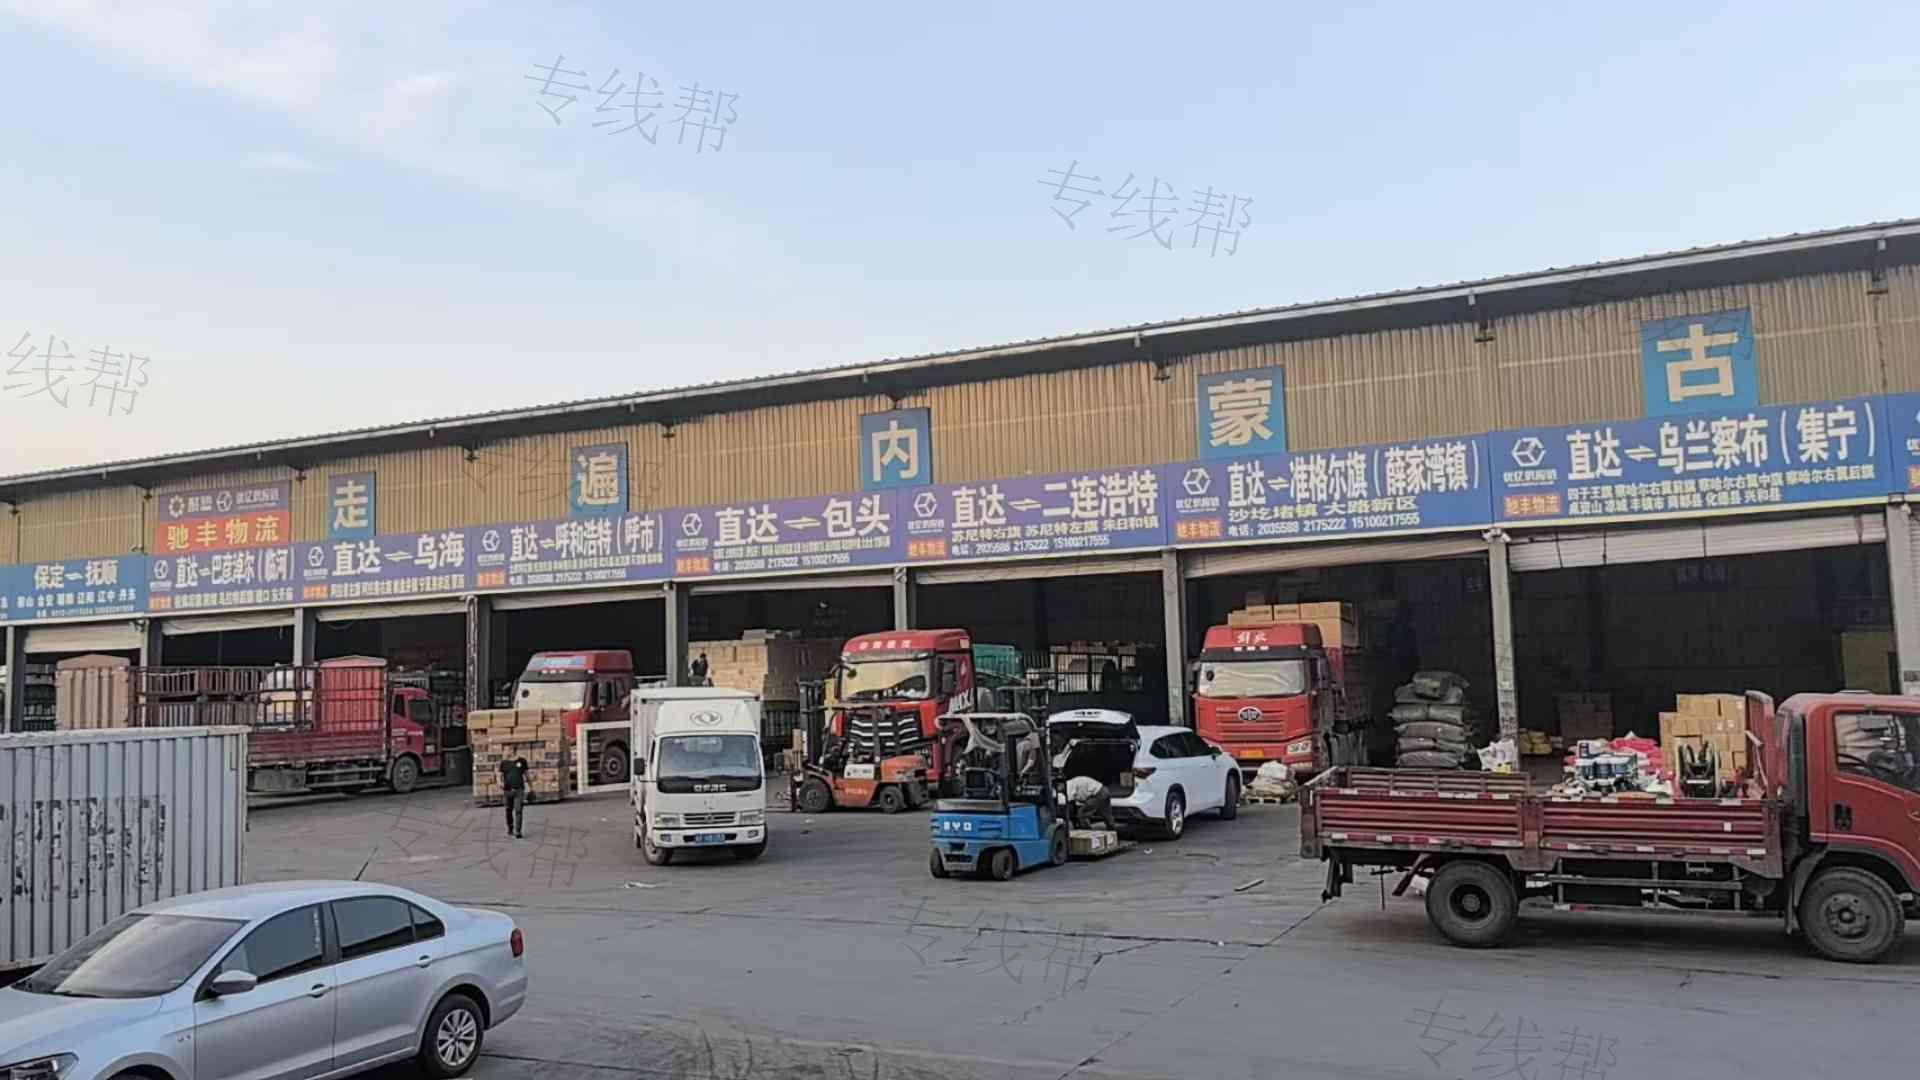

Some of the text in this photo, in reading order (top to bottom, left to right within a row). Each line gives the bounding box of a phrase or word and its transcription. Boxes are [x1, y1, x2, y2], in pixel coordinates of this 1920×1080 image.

[333, 323, 1739, 530] 走 遍 内 蒙 古
[1565, 427, 1623, 481] 直达
[951, 470, 1158, 528] 直达 二连浩特
[1227, 460, 1266, 507] 直达
[713, 495, 891, 546] 直达 包头
[1303, 517, 1347, 533] 2175222
[1324, 496, 1417, 516] 大路新区
[167, 515, 280, 550] 驰丰物流
[510, 525, 539, 562] 直达
[175, 555, 199, 589] 直达
[332, 539, 382, 576] 直达
[414, 531, 465, 570] 乌海
[943, 821, 973, 832] BYD
